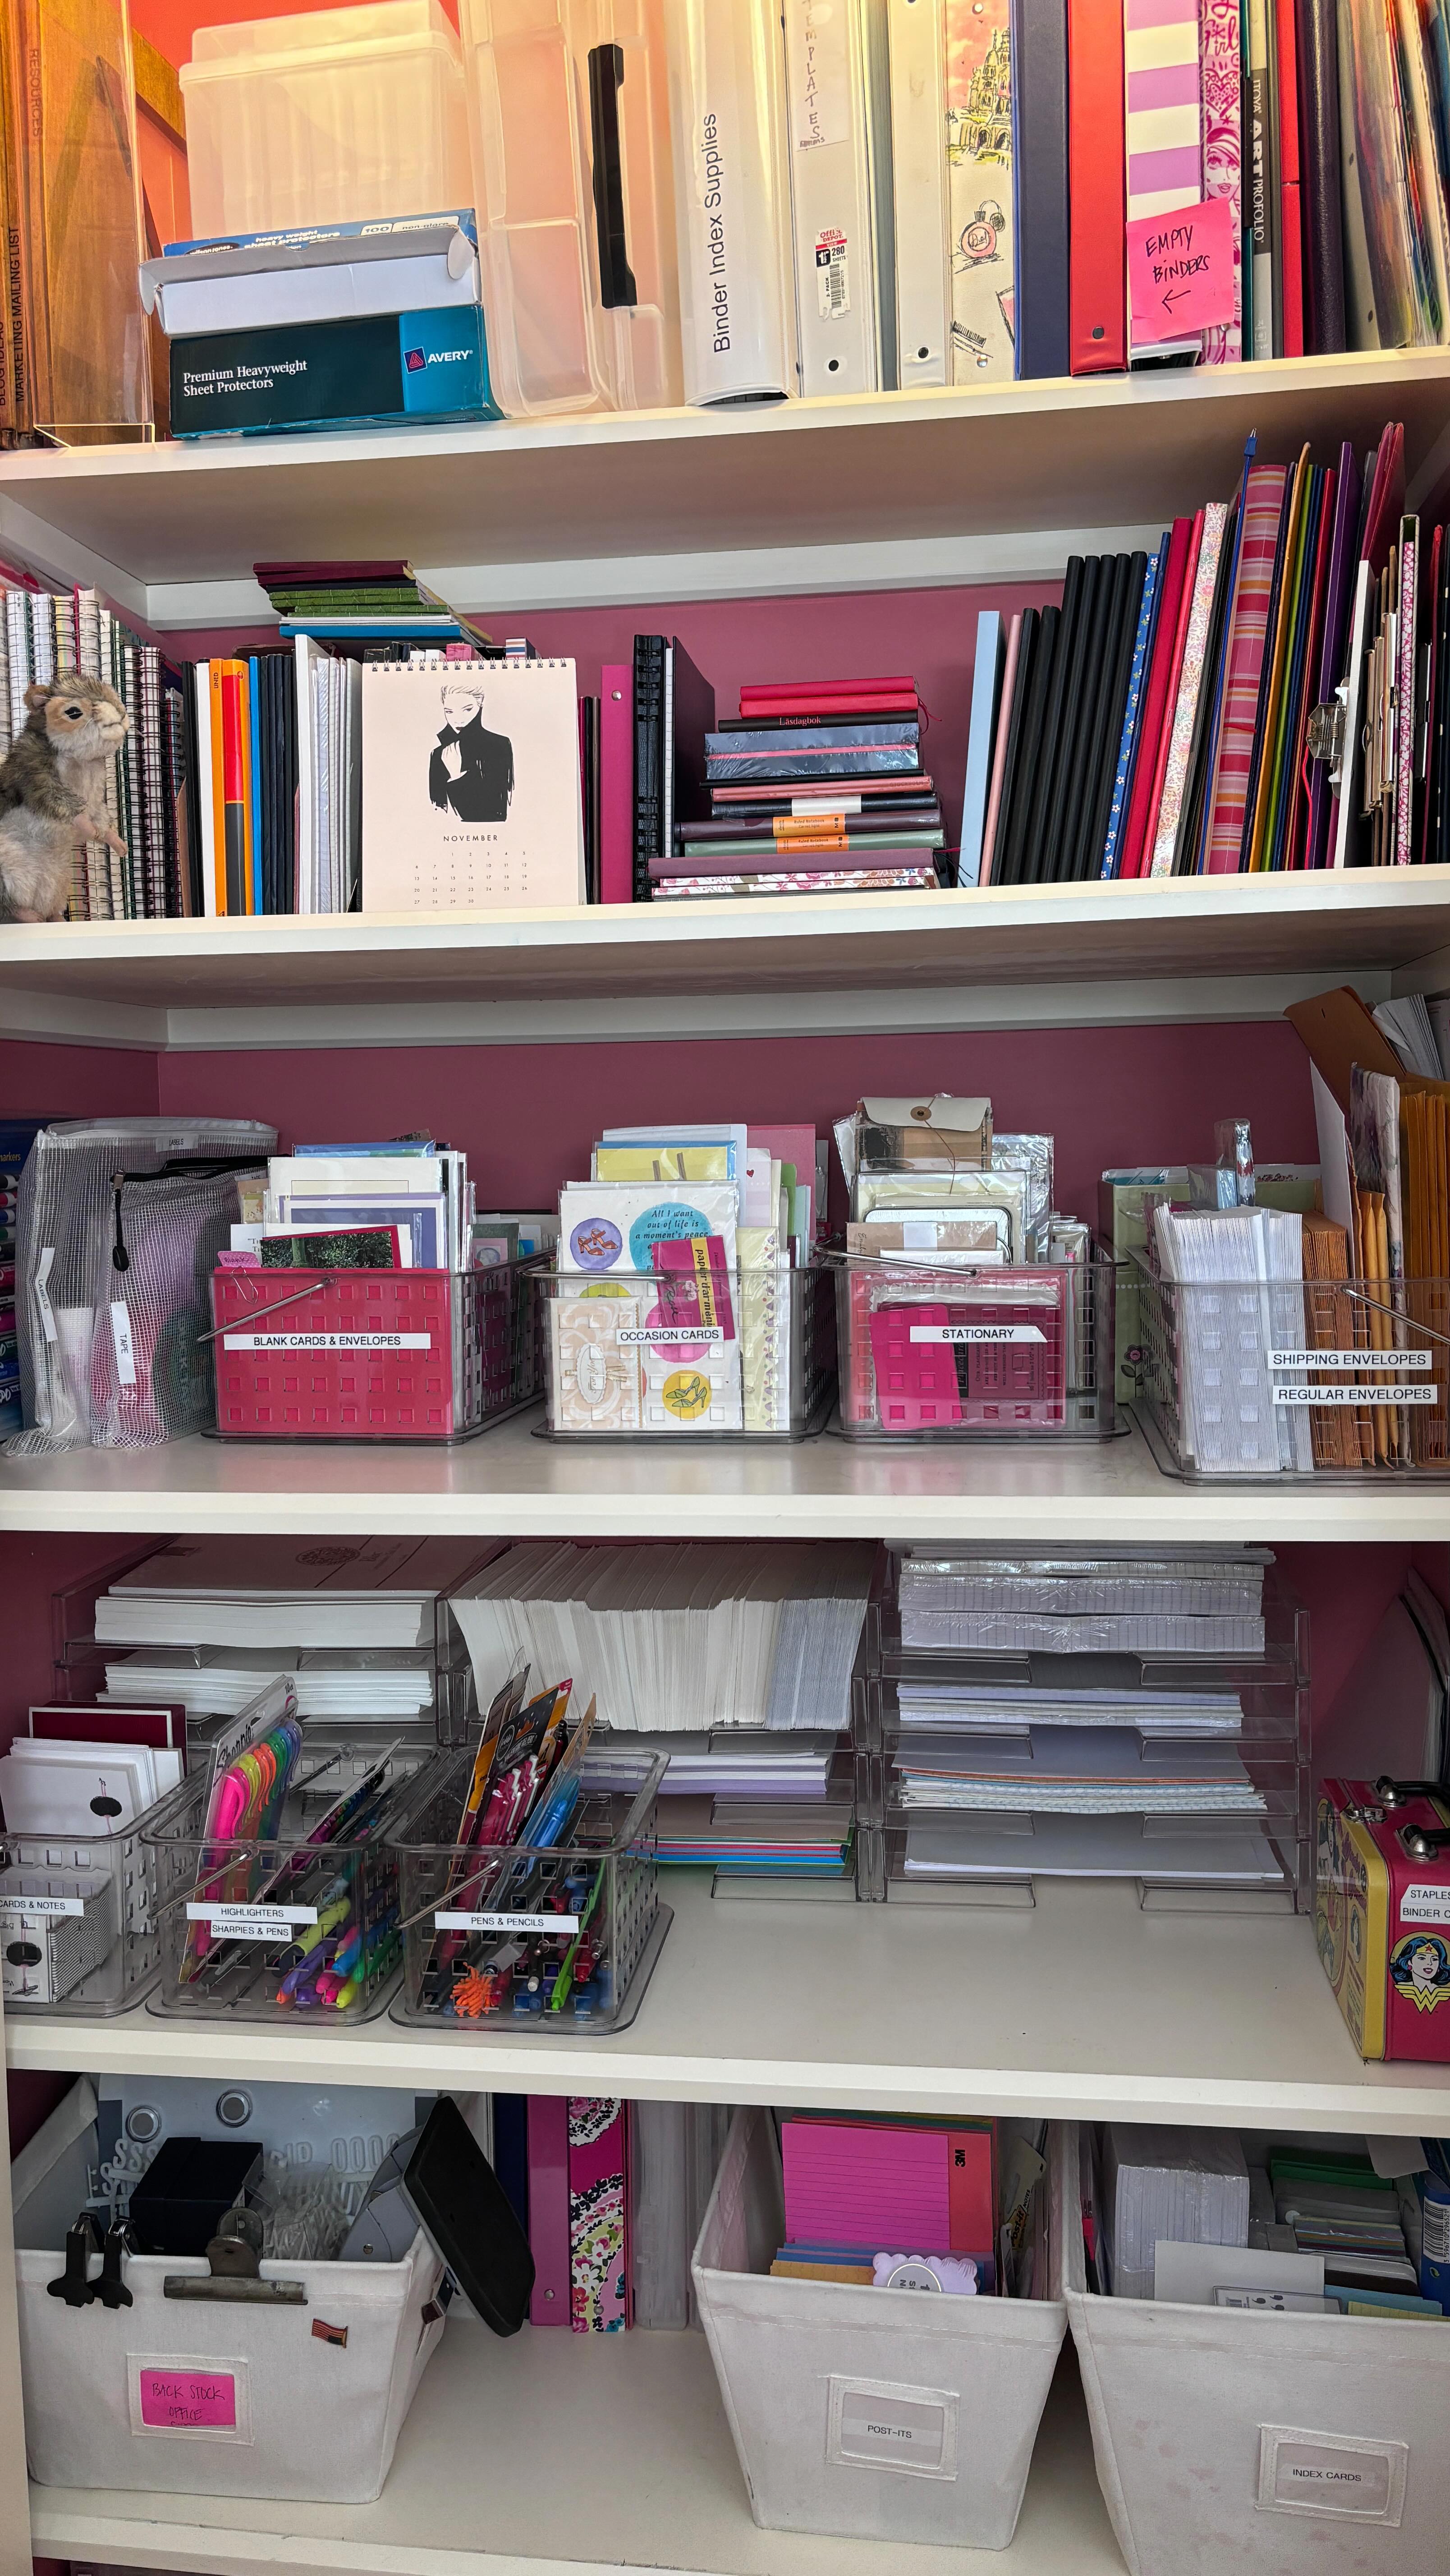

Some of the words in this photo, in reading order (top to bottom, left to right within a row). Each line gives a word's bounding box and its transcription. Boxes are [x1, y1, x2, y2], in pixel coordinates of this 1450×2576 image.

[703, 113, 723, 207] Supplies
[8, 227, 19, 255] LIST
[707, 214, 726, 275] Index
[1146, 225, 1193, 257] EMPTY
[832, 246, 844, 256] 280
[10, 258, 22, 317] MAILING
[711, 283, 731, 353] Binder
[13, 320, 24, 402] MARKETING
[183, 369, 234, 384] Premium
[237, 360, 307, 378] Heavyweight
[184, 385, 214, 397] Sheet
[217, 378, 273, 394] Protectors
[779, 716, 821, 727] Läsdagbok
[664, 1220, 671, 1229] of
[675, 1220, 688, 1229] life
[643, 1231, 681, 1239] moment's
[38, 1279, 49, 1310] LABELS
[253, 1336, 288, 1345] BLANK
[290, 1336, 326, 1345] CARDS
[330, 1336, 336, 1345] &
[339, 1336, 401, 1345] ENVELOPES
[620, 1330, 678, 1342] OCCASION
[681, 1330, 719, 1339] CARDS
[942, 1329, 1014, 1339] STATIONARY
[119, 1333, 129, 1355] TAPE
[1273, 1354, 1339, 1366] SHIPPING
[1343, 1354, 1427, 1366] ENVELOPES
[1279, 1389, 1344, 1400] REGULAR
[1348, 1388, 1432, 1400] ENVELOPES
[37, 1901, 65, 1910] NOTES
[221, 1908, 284, 1917] HIGHLIGHTERS
[1403, 1908, 1440, 1918] BINDER
[471, 1917, 495, 1926] PENS
[497, 1918, 504, 1926] &
[507, 1918, 544, 1927] PENCILS
[212, 1925, 255, 1934] SHARPIES
[266, 1928, 289, 1936] PENS
[954, 2148, 966, 2167] 3M
[152, 2383, 184, 2399] BACK
[190, 2385, 225, 2400] STOCK
[169, 2406, 205, 2421] OFFICE
[868, 2424, 912, 2438] POST-ITS
[1293, 2469, 1322, 2478] INDEX
[1326, 2472, 1362, 2481] CARDS
